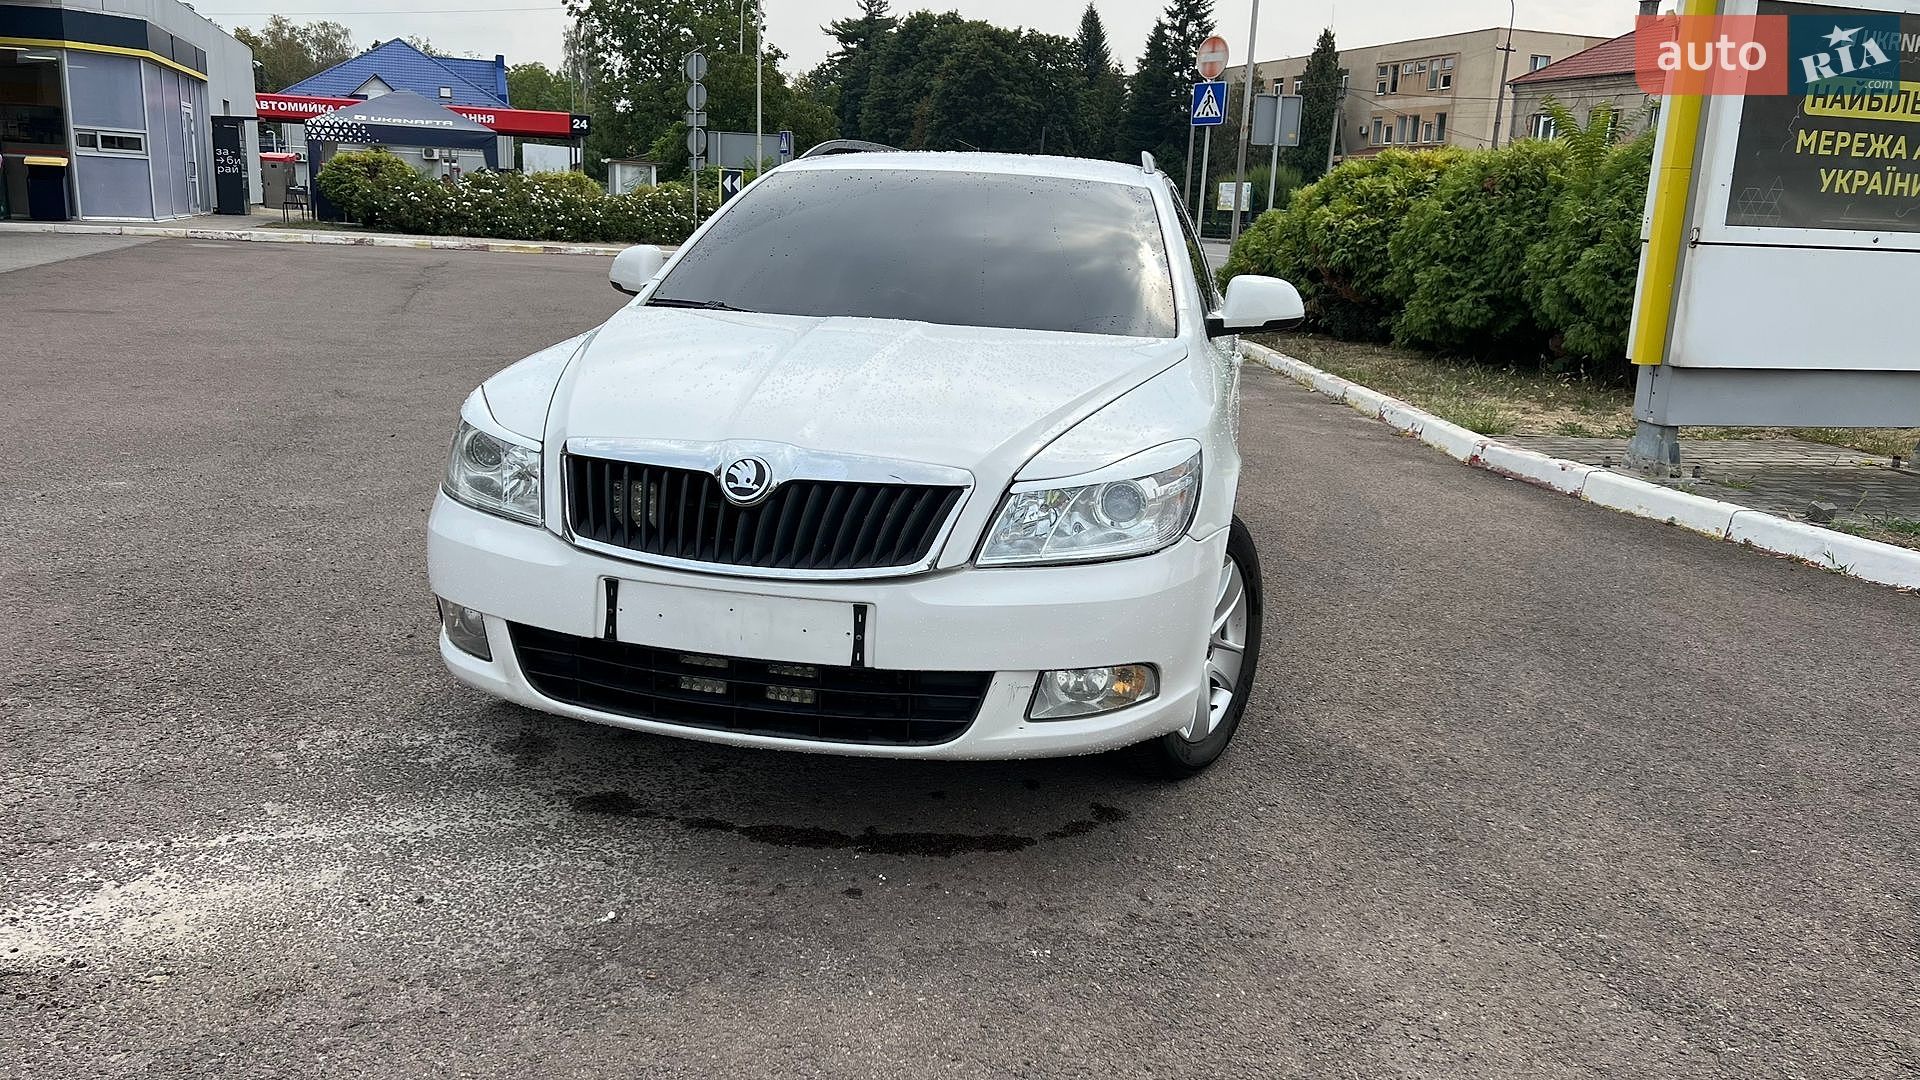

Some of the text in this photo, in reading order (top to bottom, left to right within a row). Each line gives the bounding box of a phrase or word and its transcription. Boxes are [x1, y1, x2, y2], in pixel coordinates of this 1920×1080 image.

[370, 116, 453, 126] UKRNAFTA
[572, 119, 588, 129] 24
[1795, 129, 1907, 160] МЕРЕЖА
[217, 165, 239, 174] рай
